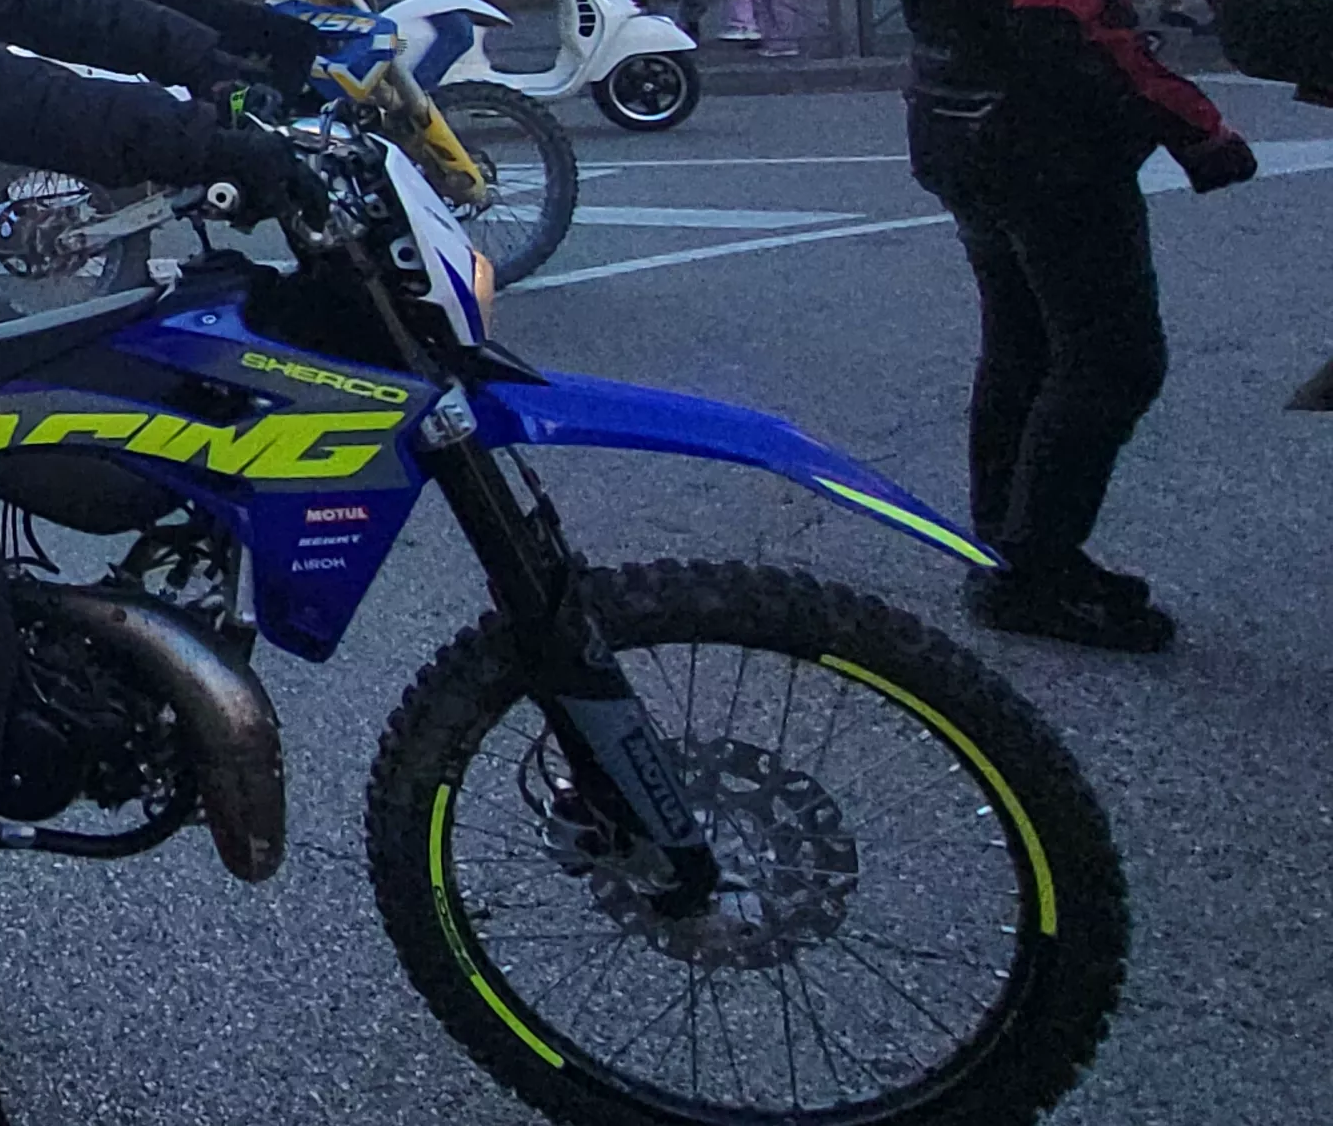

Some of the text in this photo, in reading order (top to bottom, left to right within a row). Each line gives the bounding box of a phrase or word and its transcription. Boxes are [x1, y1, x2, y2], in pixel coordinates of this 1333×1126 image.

[241, 352, 409, 405] SHERCO
[306, 507, 368, 522] MOTUL
[626, 736, 688, 832] MOTUL
